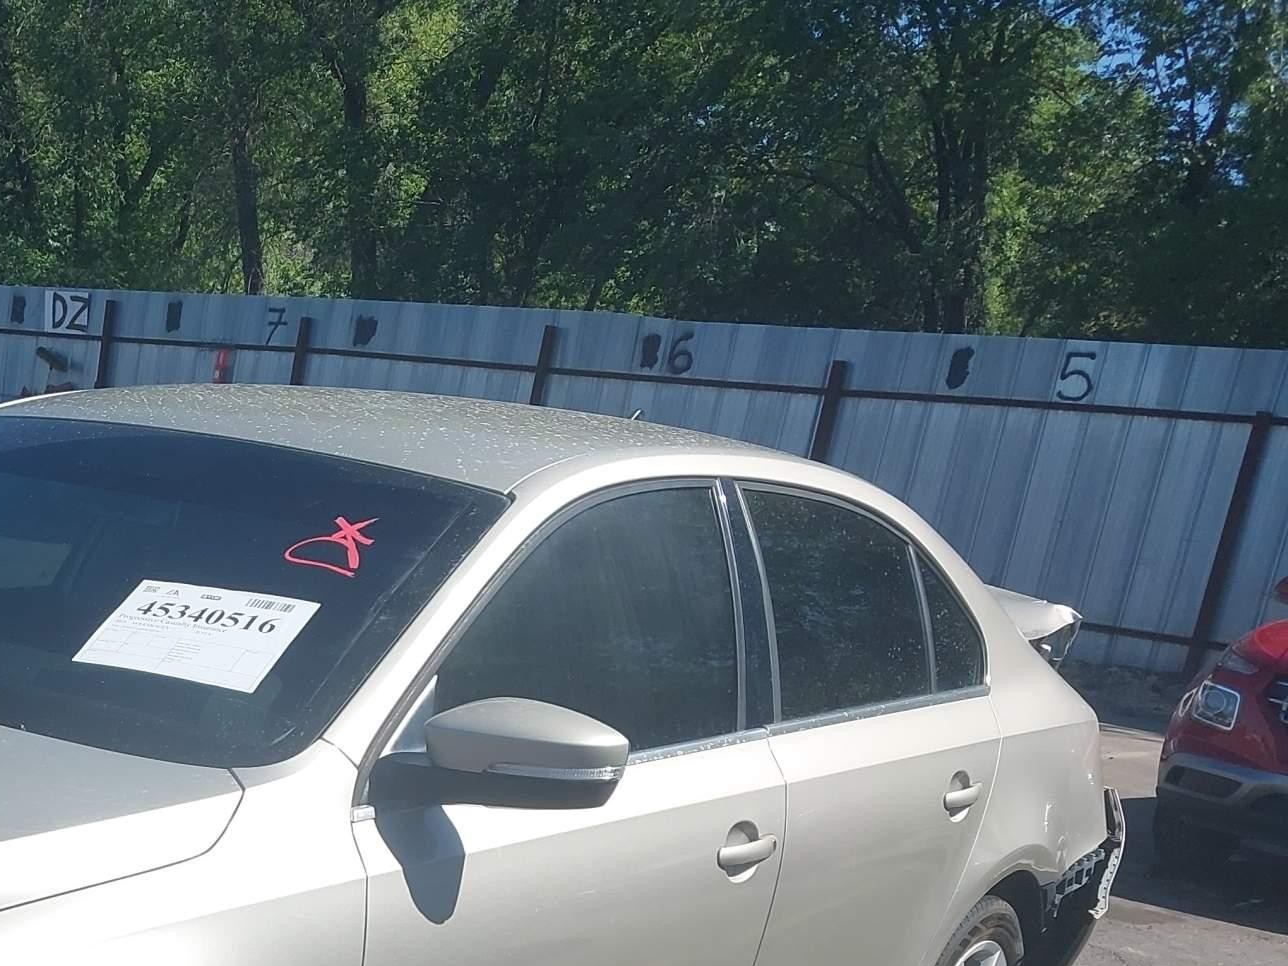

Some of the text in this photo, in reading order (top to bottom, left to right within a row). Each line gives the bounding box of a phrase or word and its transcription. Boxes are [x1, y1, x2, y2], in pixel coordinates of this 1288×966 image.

[268, 307, 289, 346] 7
[667, 331, 696, 375] 6
[1056, 351, 1097, 402] 5
[136, 600, 282, 635] 45340516
